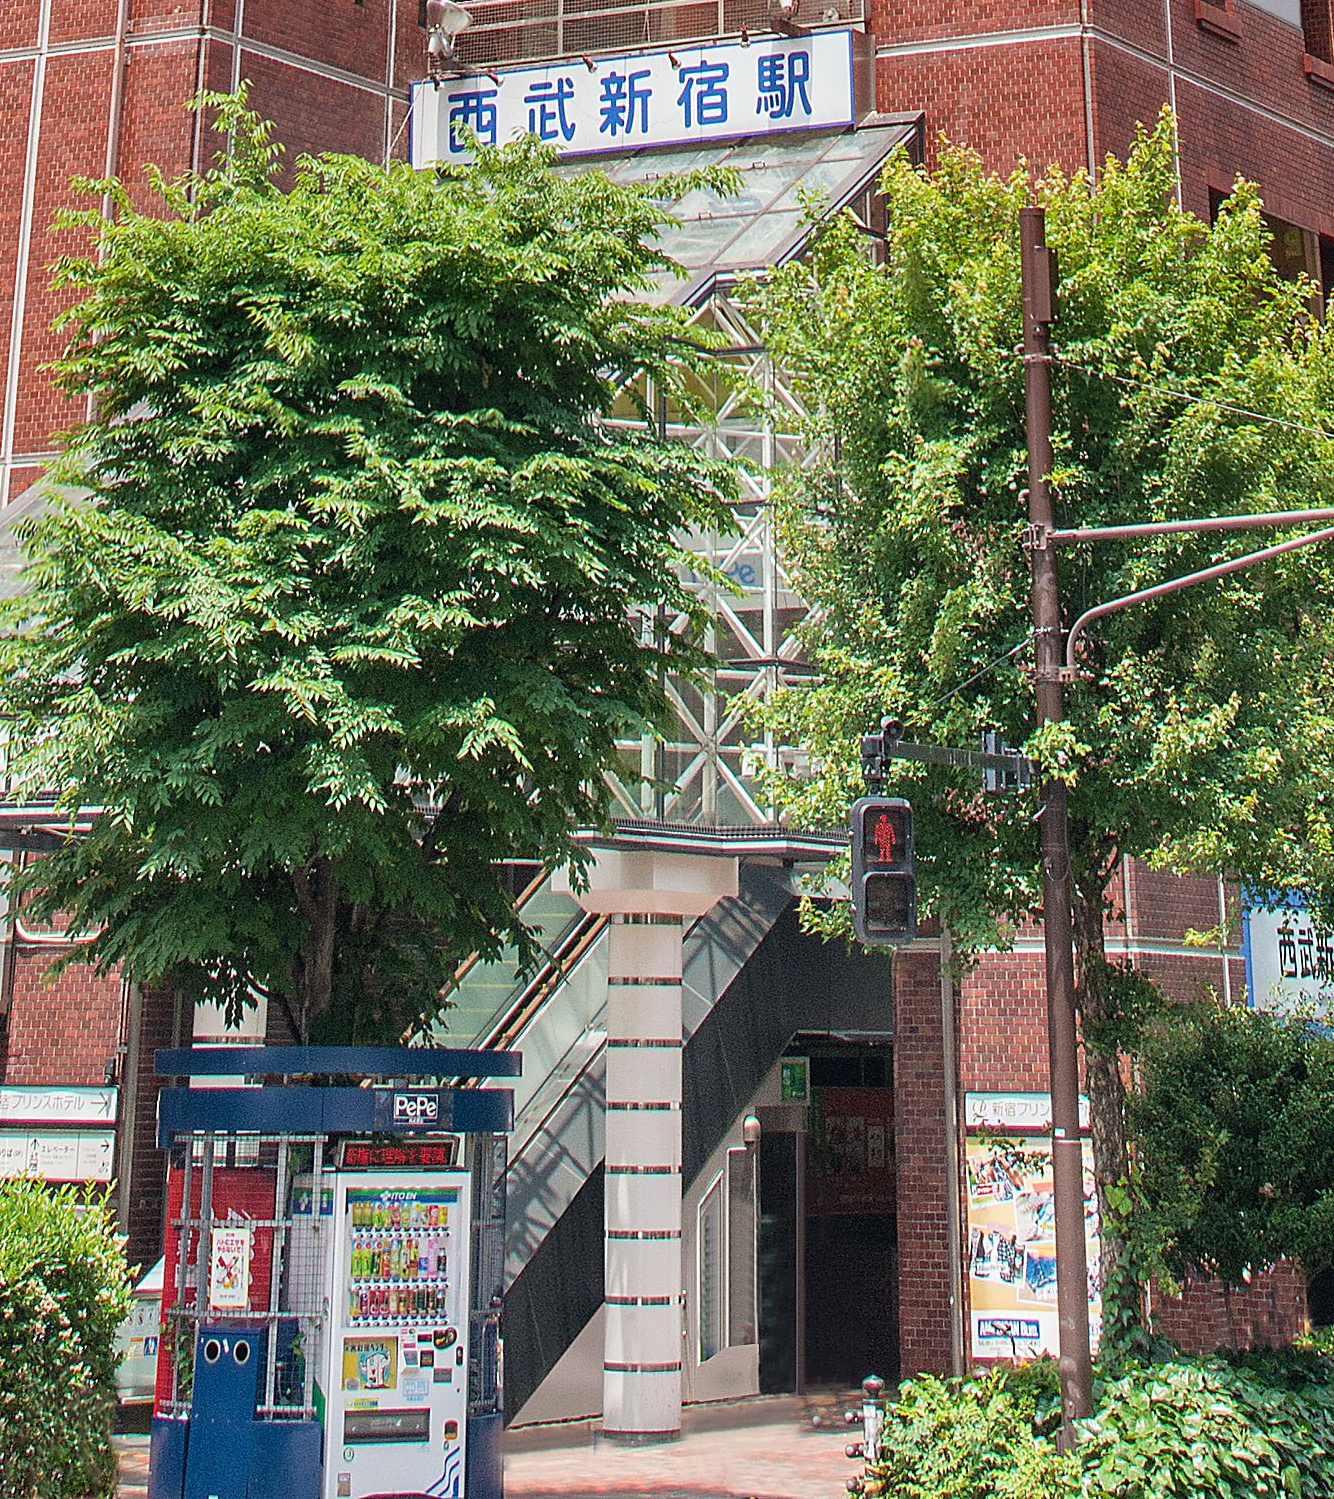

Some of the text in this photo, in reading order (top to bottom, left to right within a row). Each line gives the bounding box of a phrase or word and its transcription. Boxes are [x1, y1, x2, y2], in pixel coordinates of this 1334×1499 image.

[448, 50, 813, 154] 西武新宿駅
[395, 1096, 437, 1116] PePe
[992, 1102, 1050, 1117] 新宿プリン
